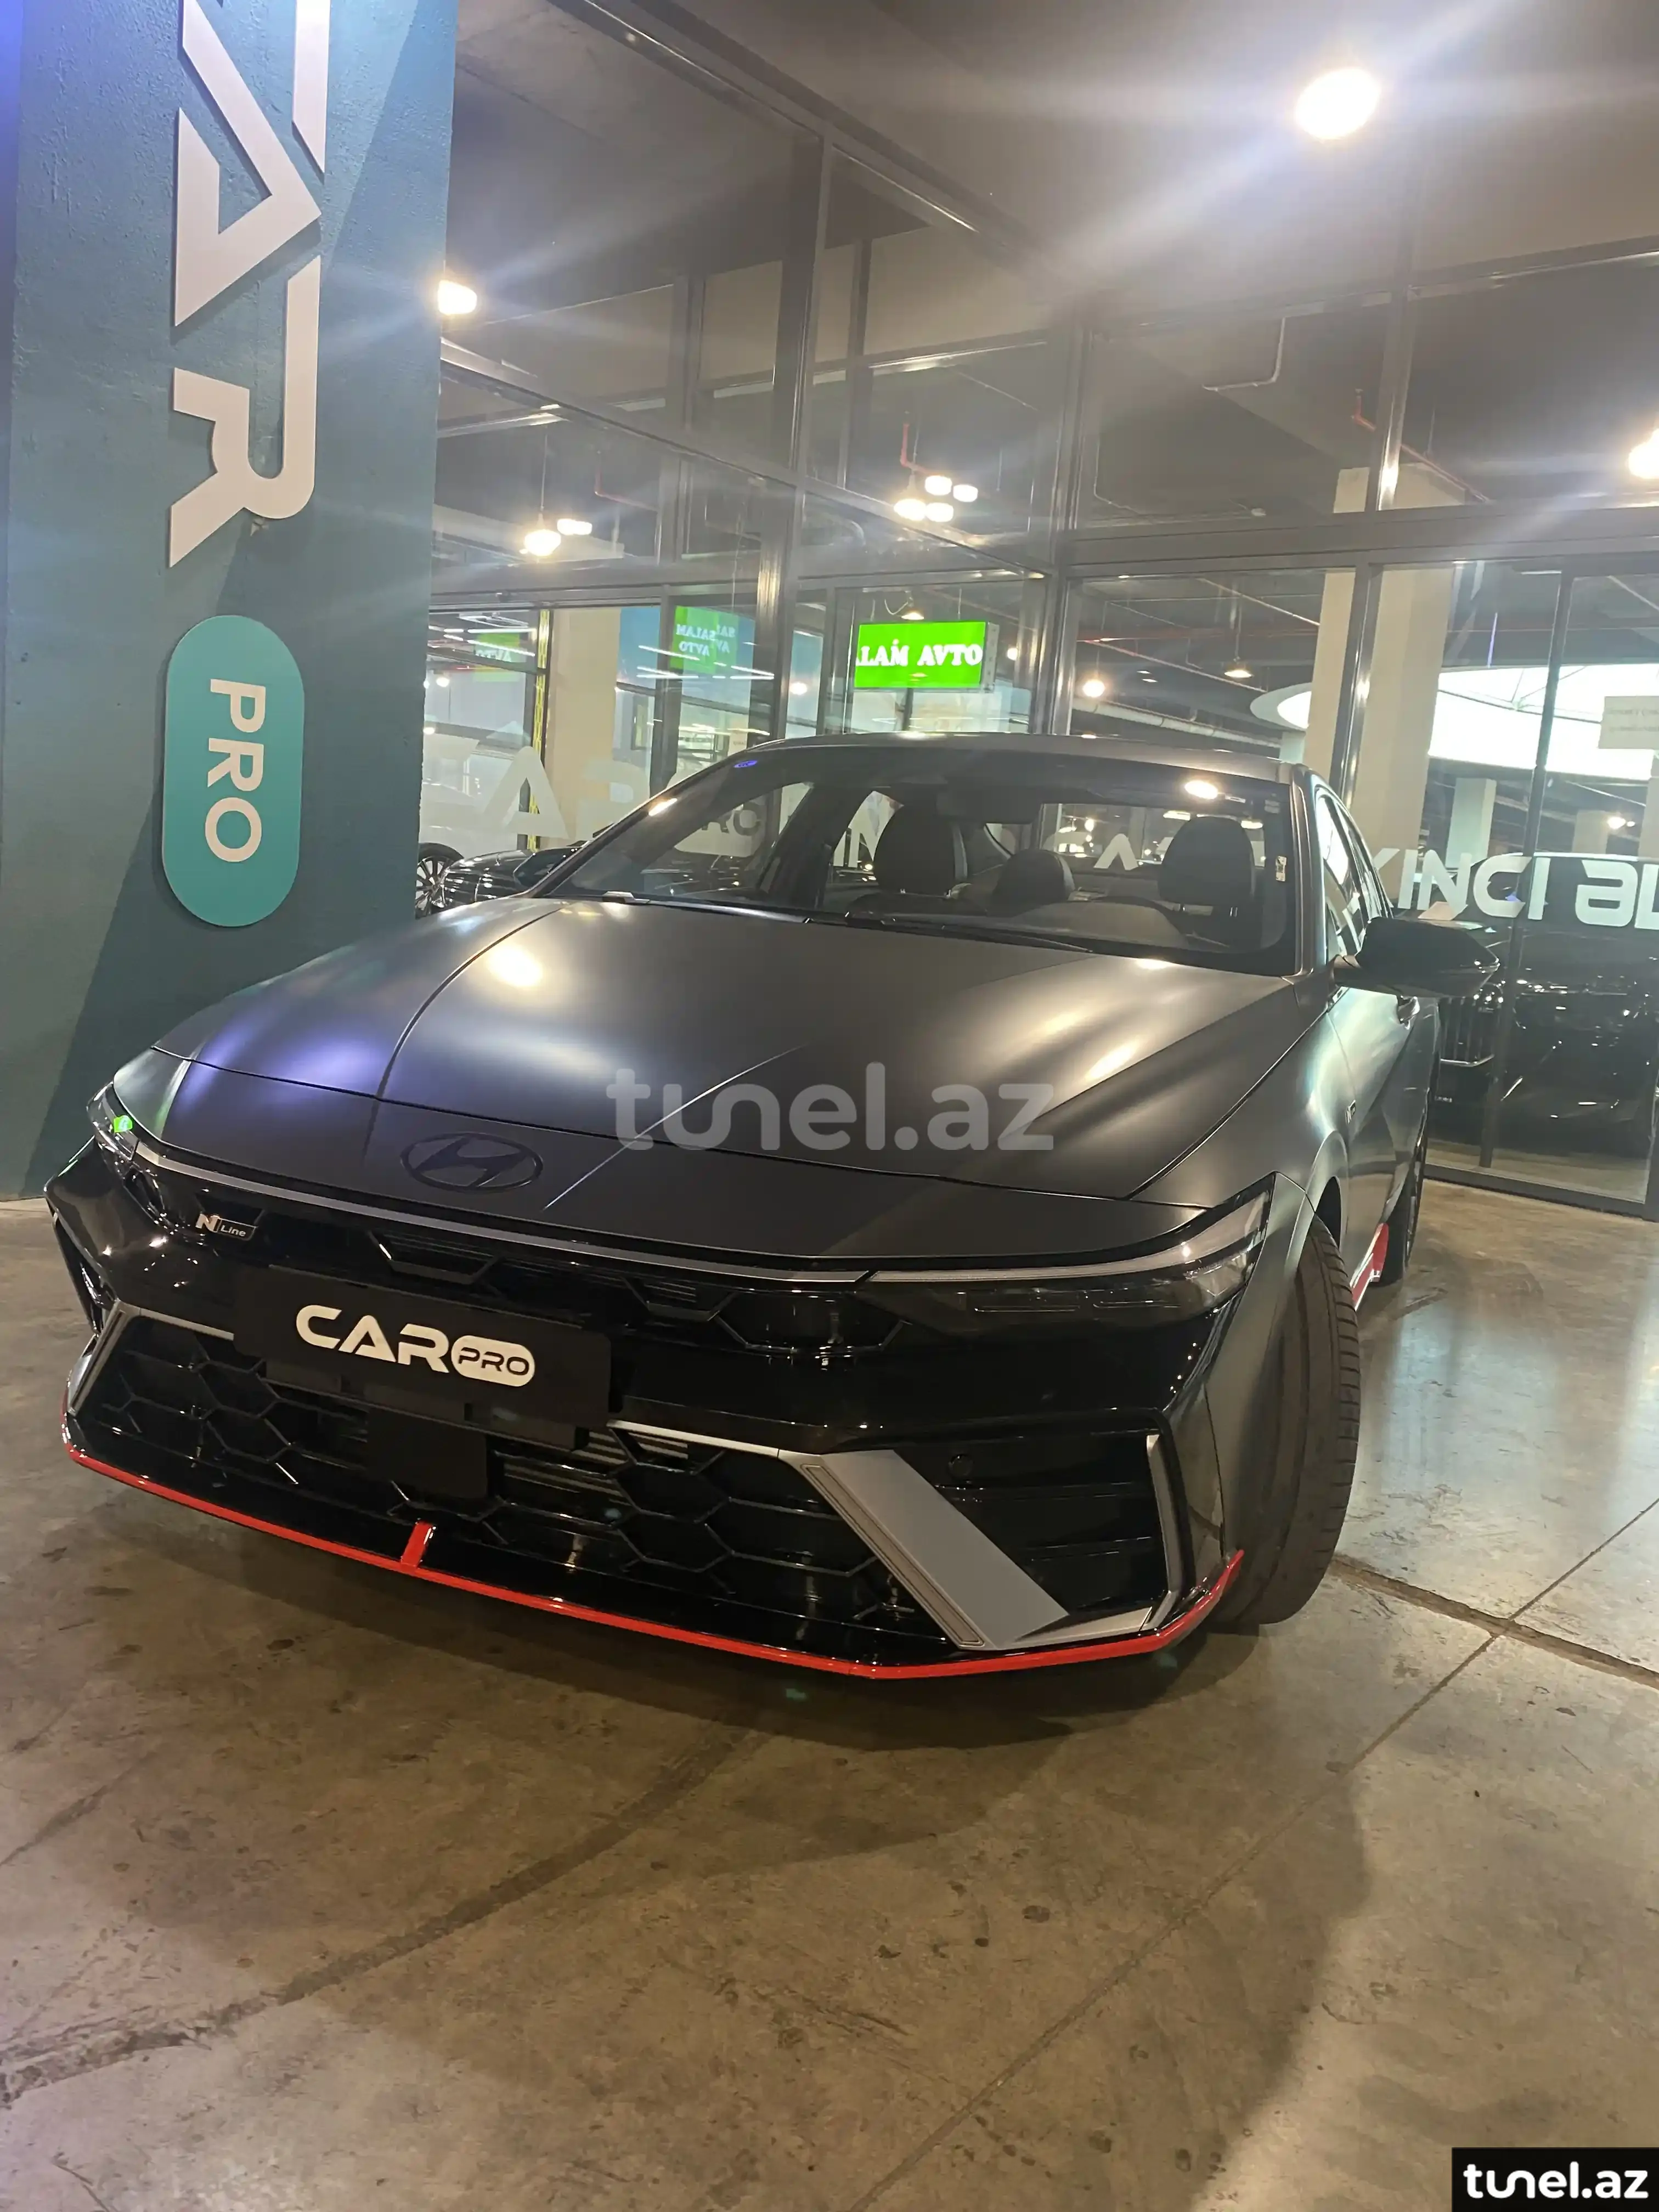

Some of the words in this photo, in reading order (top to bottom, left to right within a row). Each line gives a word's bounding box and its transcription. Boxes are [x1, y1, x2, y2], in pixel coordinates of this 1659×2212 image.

[170, 0, 329, 567] AR
[855, 645, 909, 667] LAM
[917, 644, 983, 666] AVTO
[205, 679, 266, 862] PRO
[195, 1213, 221, 1233] N
[221, 1224, 246, 1237] Line
[296, 1305, 449, 1373] CAR
[458, 1346, 530, 1376] PRO
